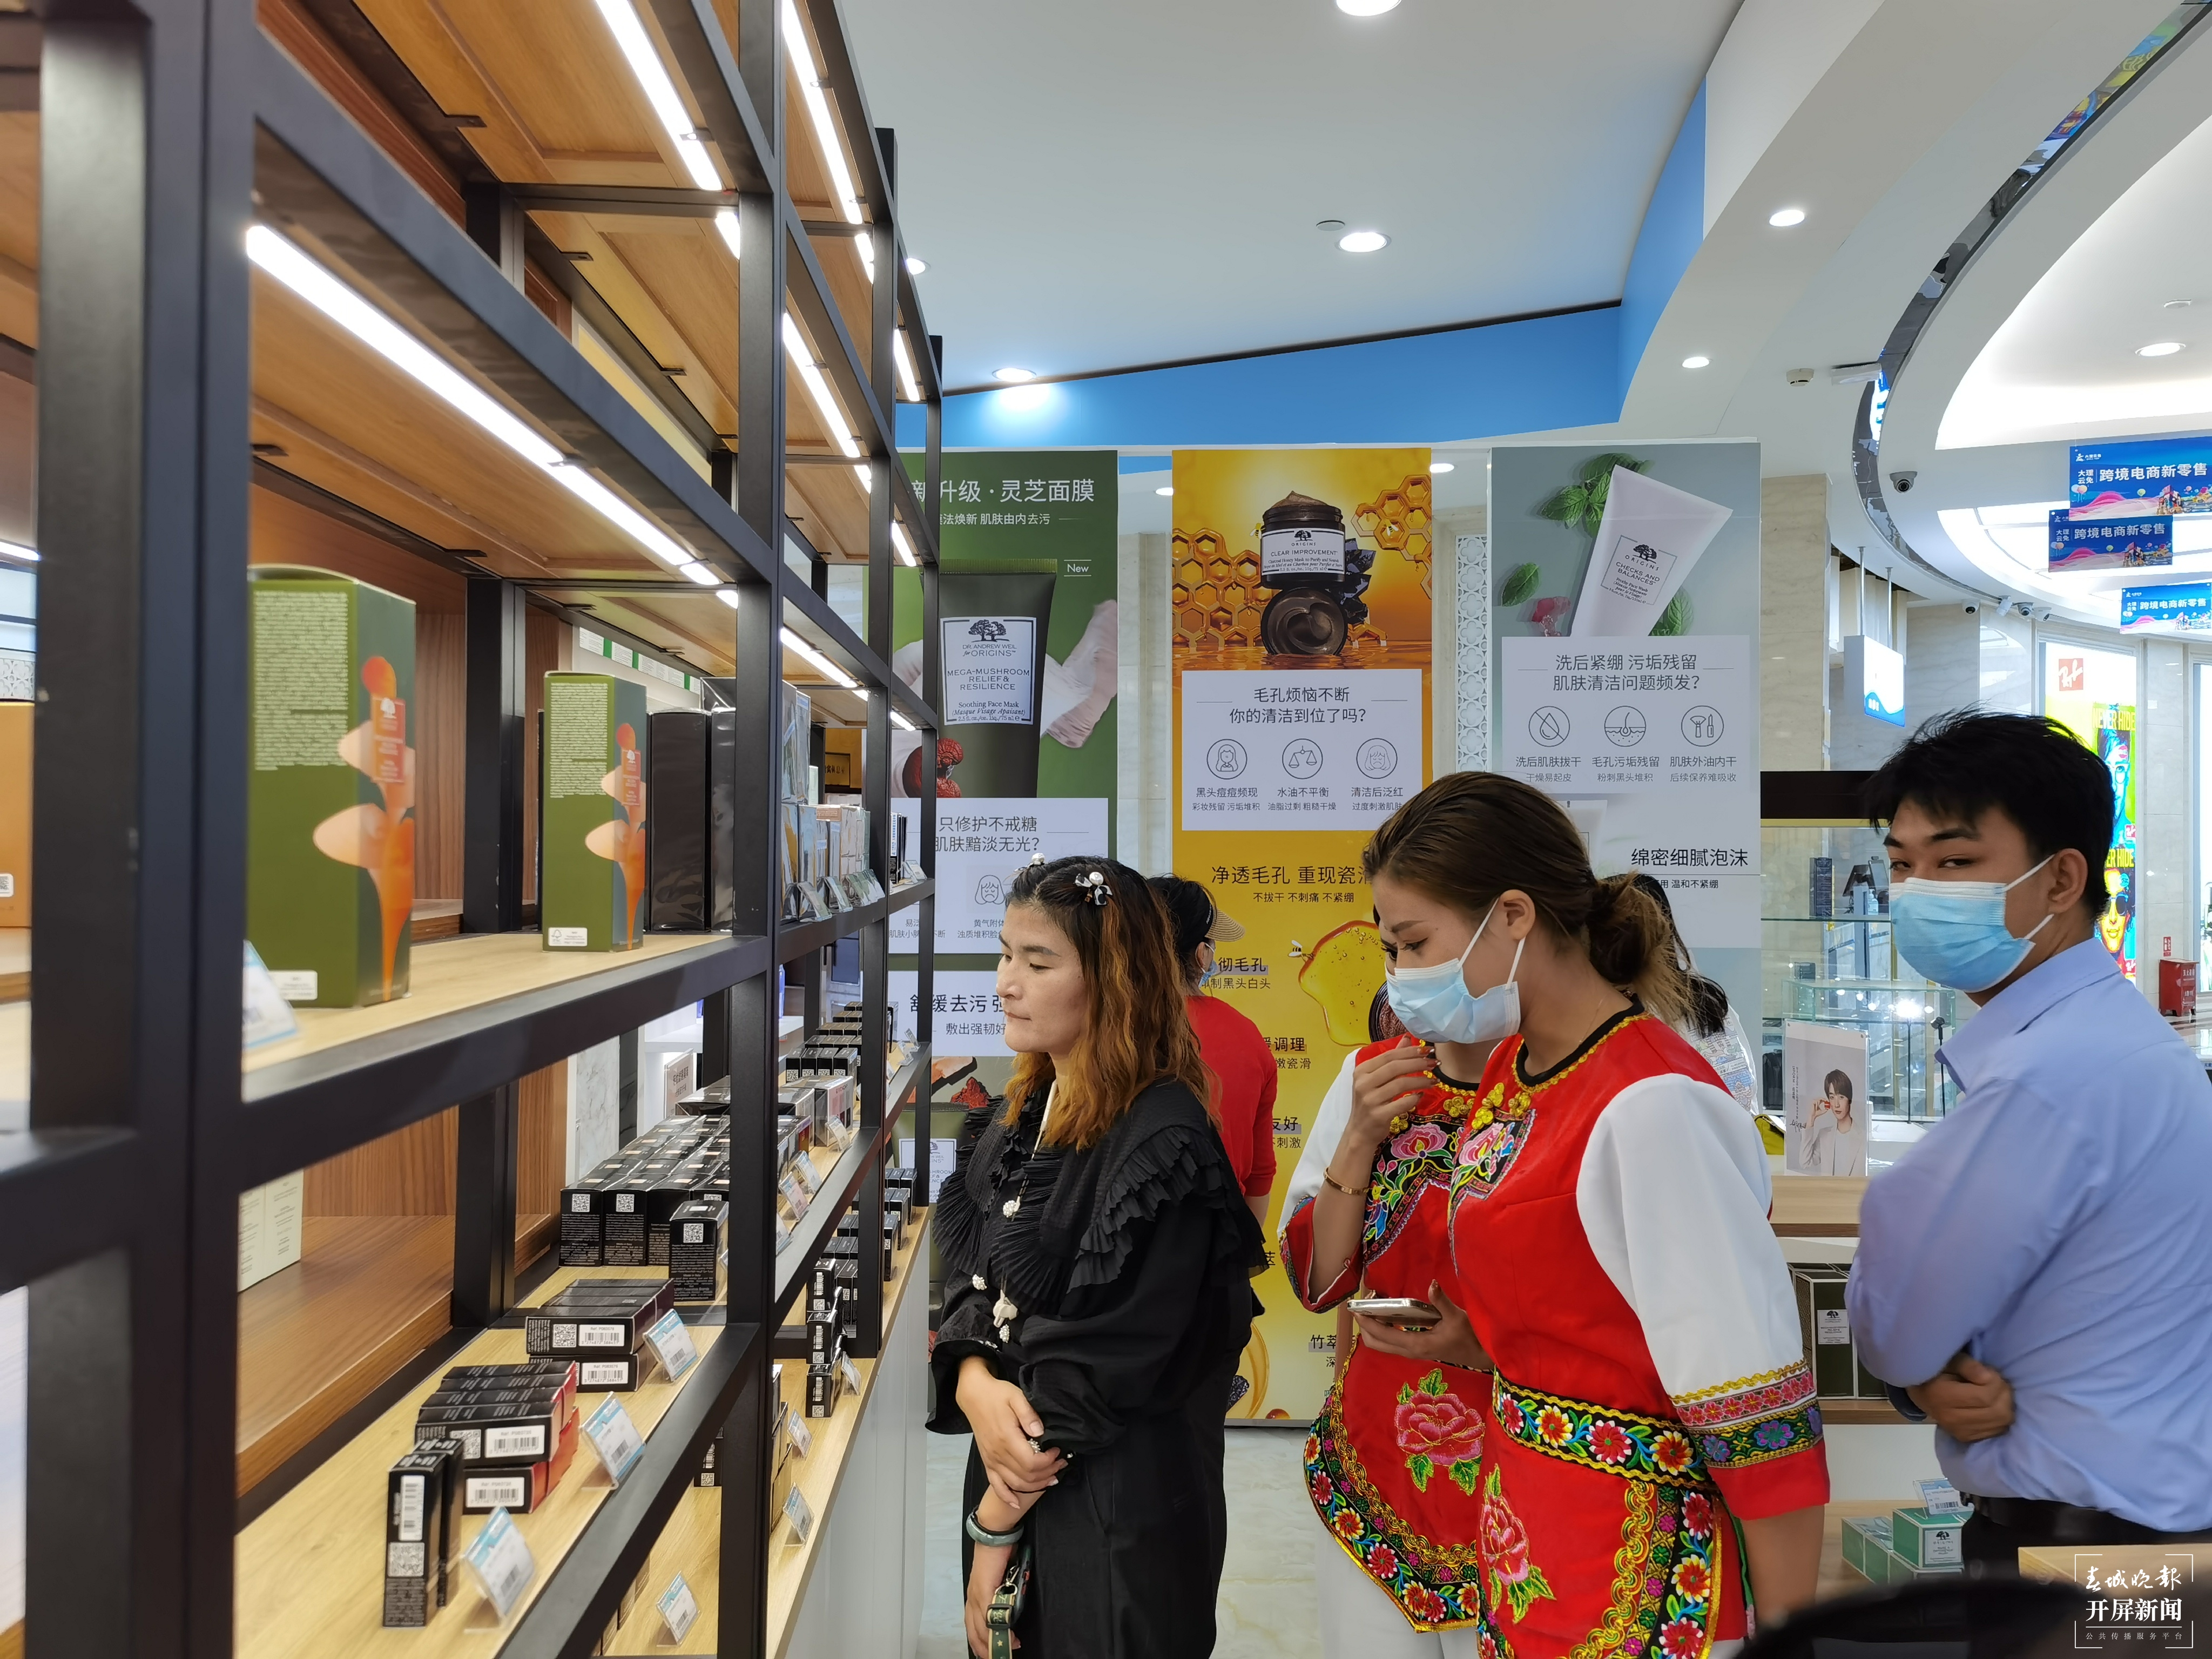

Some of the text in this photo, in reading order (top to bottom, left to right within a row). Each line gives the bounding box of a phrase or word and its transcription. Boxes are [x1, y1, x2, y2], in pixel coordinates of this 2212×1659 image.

[2100, 463, 2207, 482] 跨境电商新零售
[980, 513, 1050, 525] 肌肤由内去污
[2074, 523, 2165, 539] 跨境电商新零售
[1067, 563, 1089, 574] New
[1625, 555, 1659, 571] ORIGINS
[1616, 562, 1660, 582] CHECKS AND
[2140, 598, 2206, 610] 跨境电商新零售
[1556, 654, 1697, 671] 洗后紧绷 污垢残留
[947, 668, 1030, 677] MEGA-MUSHROOM
[1253, 687, 1350, 703] 毛孔烦恼不断
[958, 701, 987, 709] Soothing
[997, 708, 1026, 716] Apaisant)
[2118, 710, 2135, 731] HIDE
[1515, 756, 1737, 767] 洗后肌肤拔干 毛孔污垢残留 肌肤外油内干
[1526, 772, 1737, 783] 干燥易起皮 粉刺黑头堆积 后续保养难吸收
[1196, 786, 1404, 798] 黑头痘痘频现 水油不平衡 清洁后泛红
[1192, 802, 1402, 811] 彩妆残留 污垢堆积 油脂过剩 粗糙干燥 过度刺激肌肤
[939, 816, 1037, 832] 只修护不戒糖
[1631, 848, 1749, 867] 绵密细腻泡沫
[2117, 848, 2134, 868] HIDE
[1211, 866, 1290, 885] 净透毛孔
[1671, 879, 1719, 889] 温和不紧绷
[1253, 892, 1354, 903] 不拔干 不刺痛 不紧绷
[1272, 1137, 1301, 1149] 刺激
